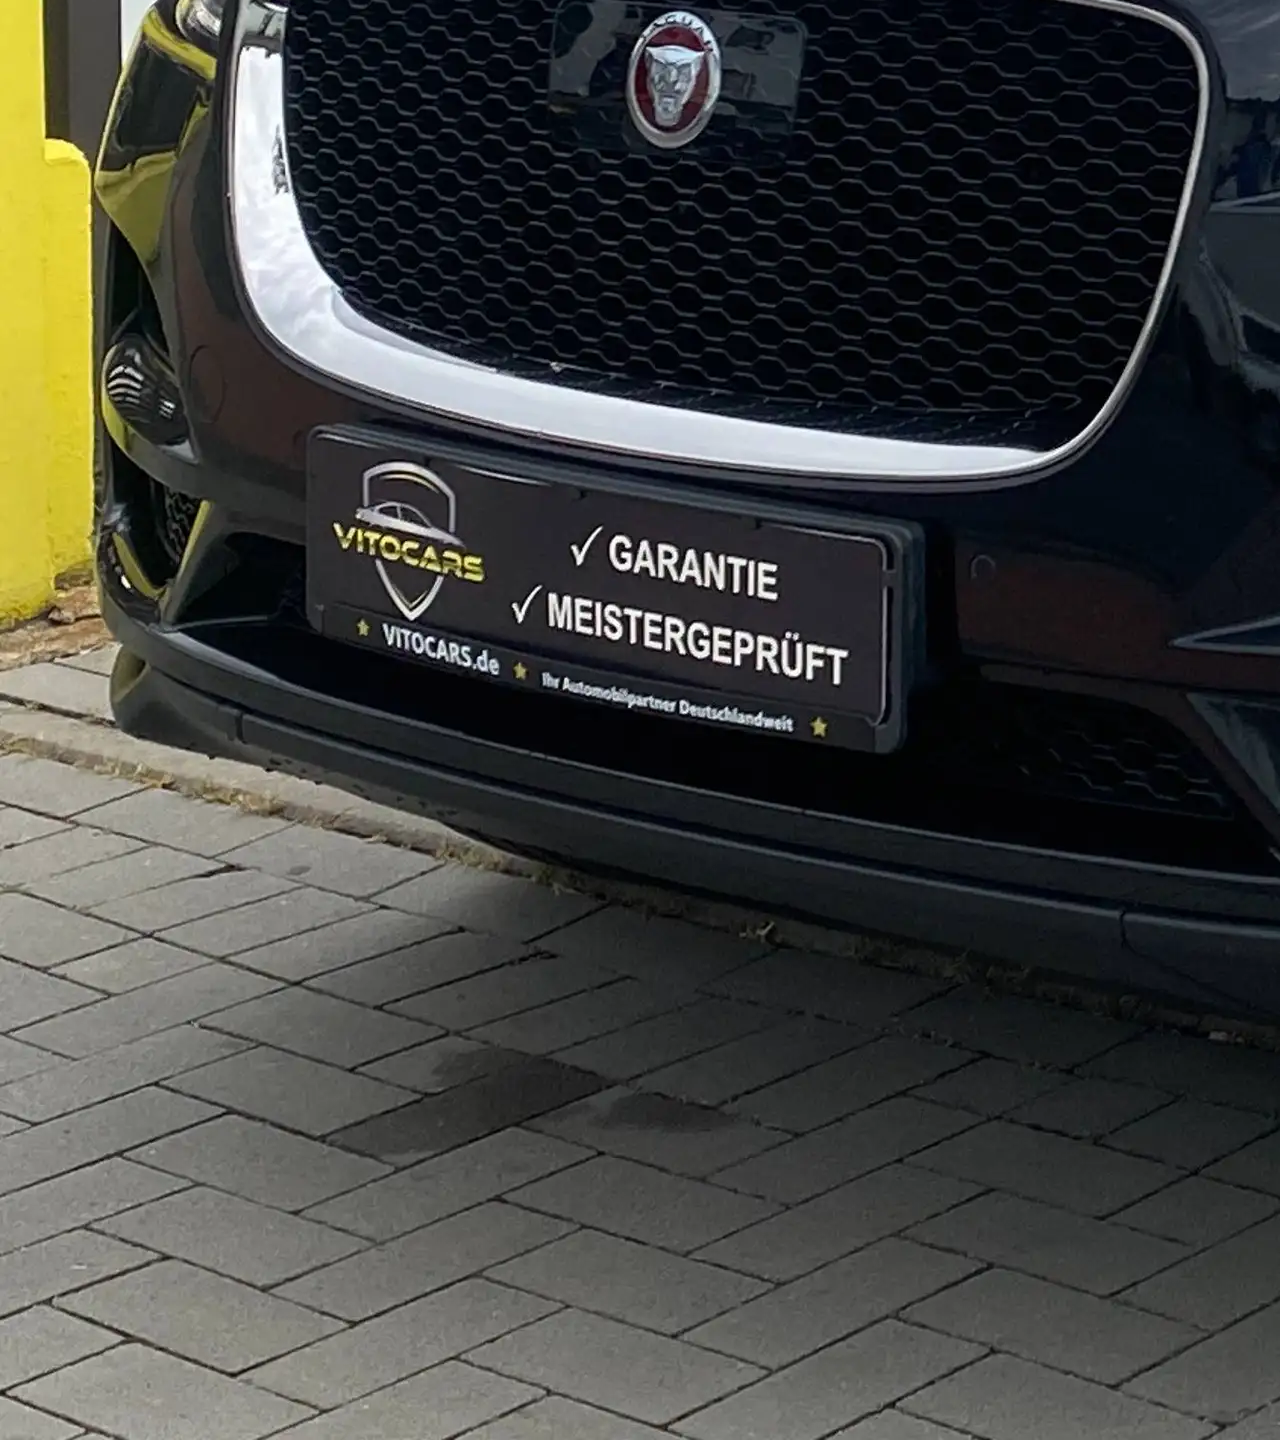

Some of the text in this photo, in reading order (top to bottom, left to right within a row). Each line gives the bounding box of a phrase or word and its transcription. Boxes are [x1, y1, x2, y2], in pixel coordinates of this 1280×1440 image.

[332, 522, 486, 583] VITOCARS
[608, 534, 779, 601] GARANTIE
[382, 623, 500, 677] VITOCARS.de
[547, 593, 849, 686] MEISTERGEPRÜFT
[542, 672, 795, 734] Ihr Automobilpartner Deutschlandweit
